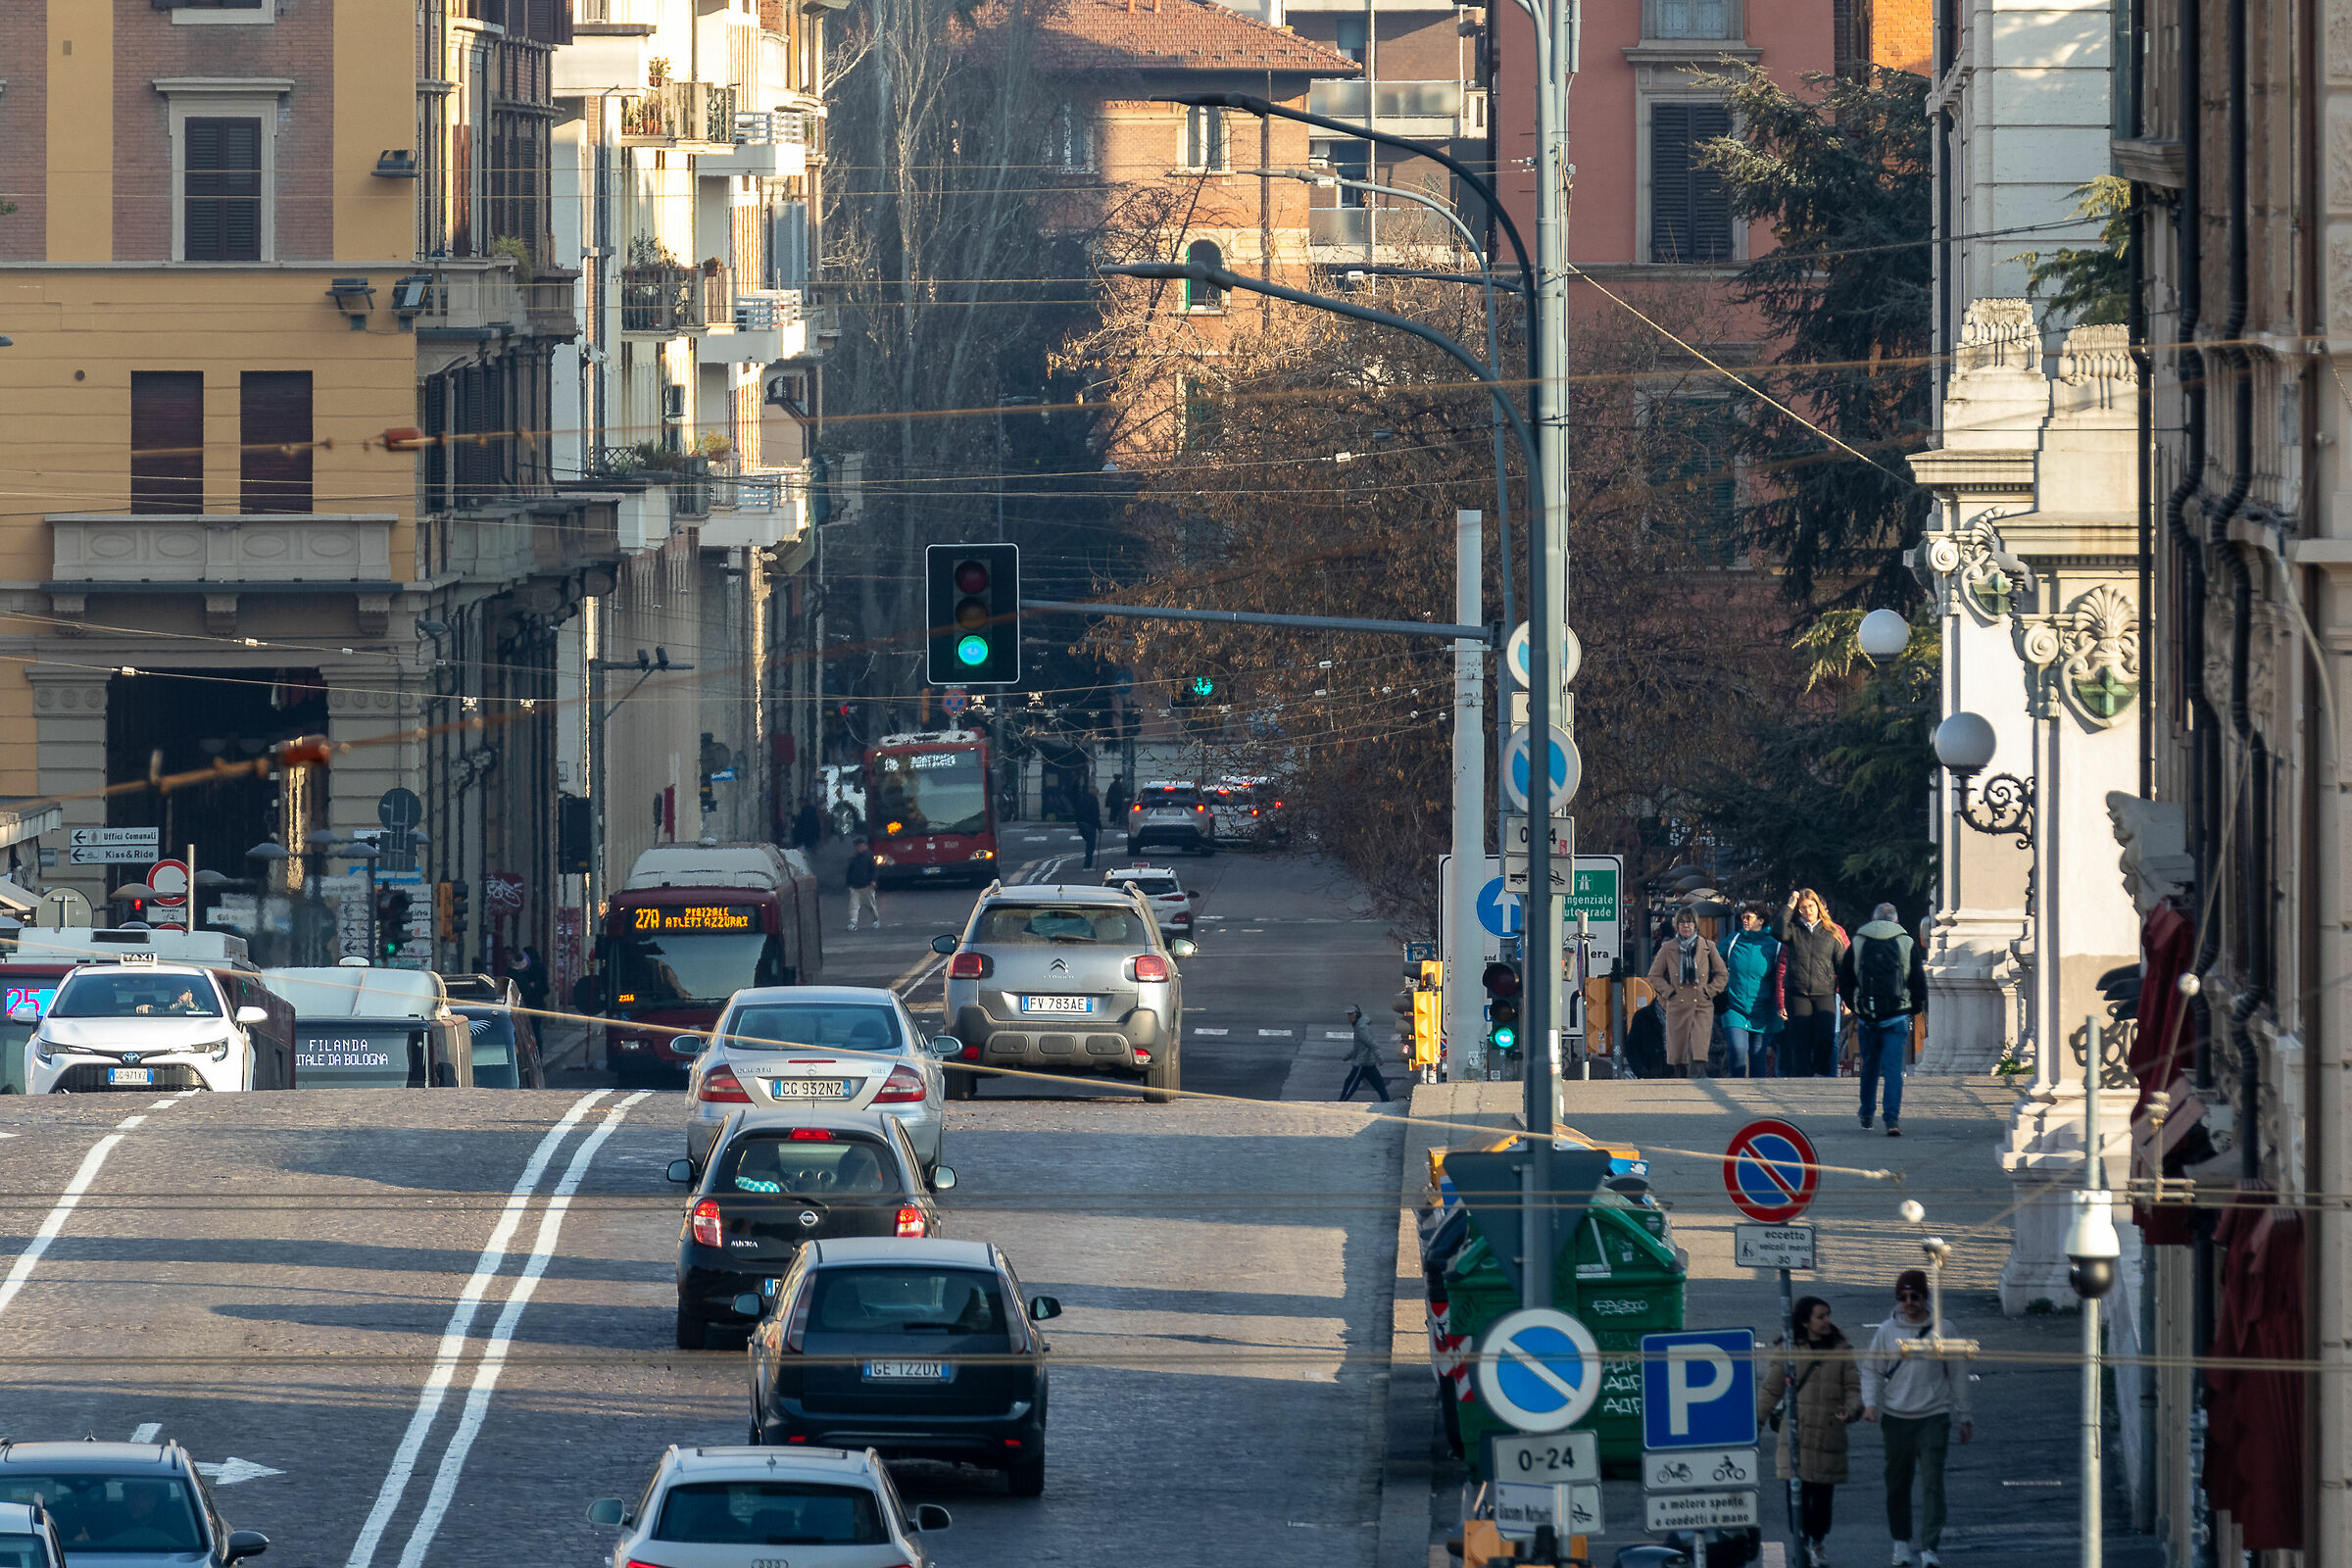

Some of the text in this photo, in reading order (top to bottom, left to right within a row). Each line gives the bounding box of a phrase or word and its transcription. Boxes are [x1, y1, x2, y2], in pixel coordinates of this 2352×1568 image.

[124, 831, 156, 840] Comunali
[105, 850, 154, 858] Kiss&Ride
[1563, 894, 1613, 906] ngenziale
[635, 908, 661, 929] 27A
[7, 988, 40, 1016] 25
[1030, 998, 1085, 1009] FV 783AE
[309, 1039, 368, 1052] FILANDA
[296, 1053, 389, 1066] ITALE DA BOLOGNA
[783, 1082, 798, 1096] CG
[803, 1082, 842, 1096] 932NZ
[1765, 1230, 1805, 1241] eccetto
[1759, 1243, 1812, 1252] veicoli merci
[874, 1362, 891, 1376] GE
[1667, 1343, 1734, 1436] P
[1518, 1446, 1576, 1472] 0-24
[1659, 1496, 1744, 1510] a motore spento
[1655, 1518, 1661, 1527] e
[1665, 1514, 1707, 1526] condotti
[1722, 1513, 1749, 1523] mano
